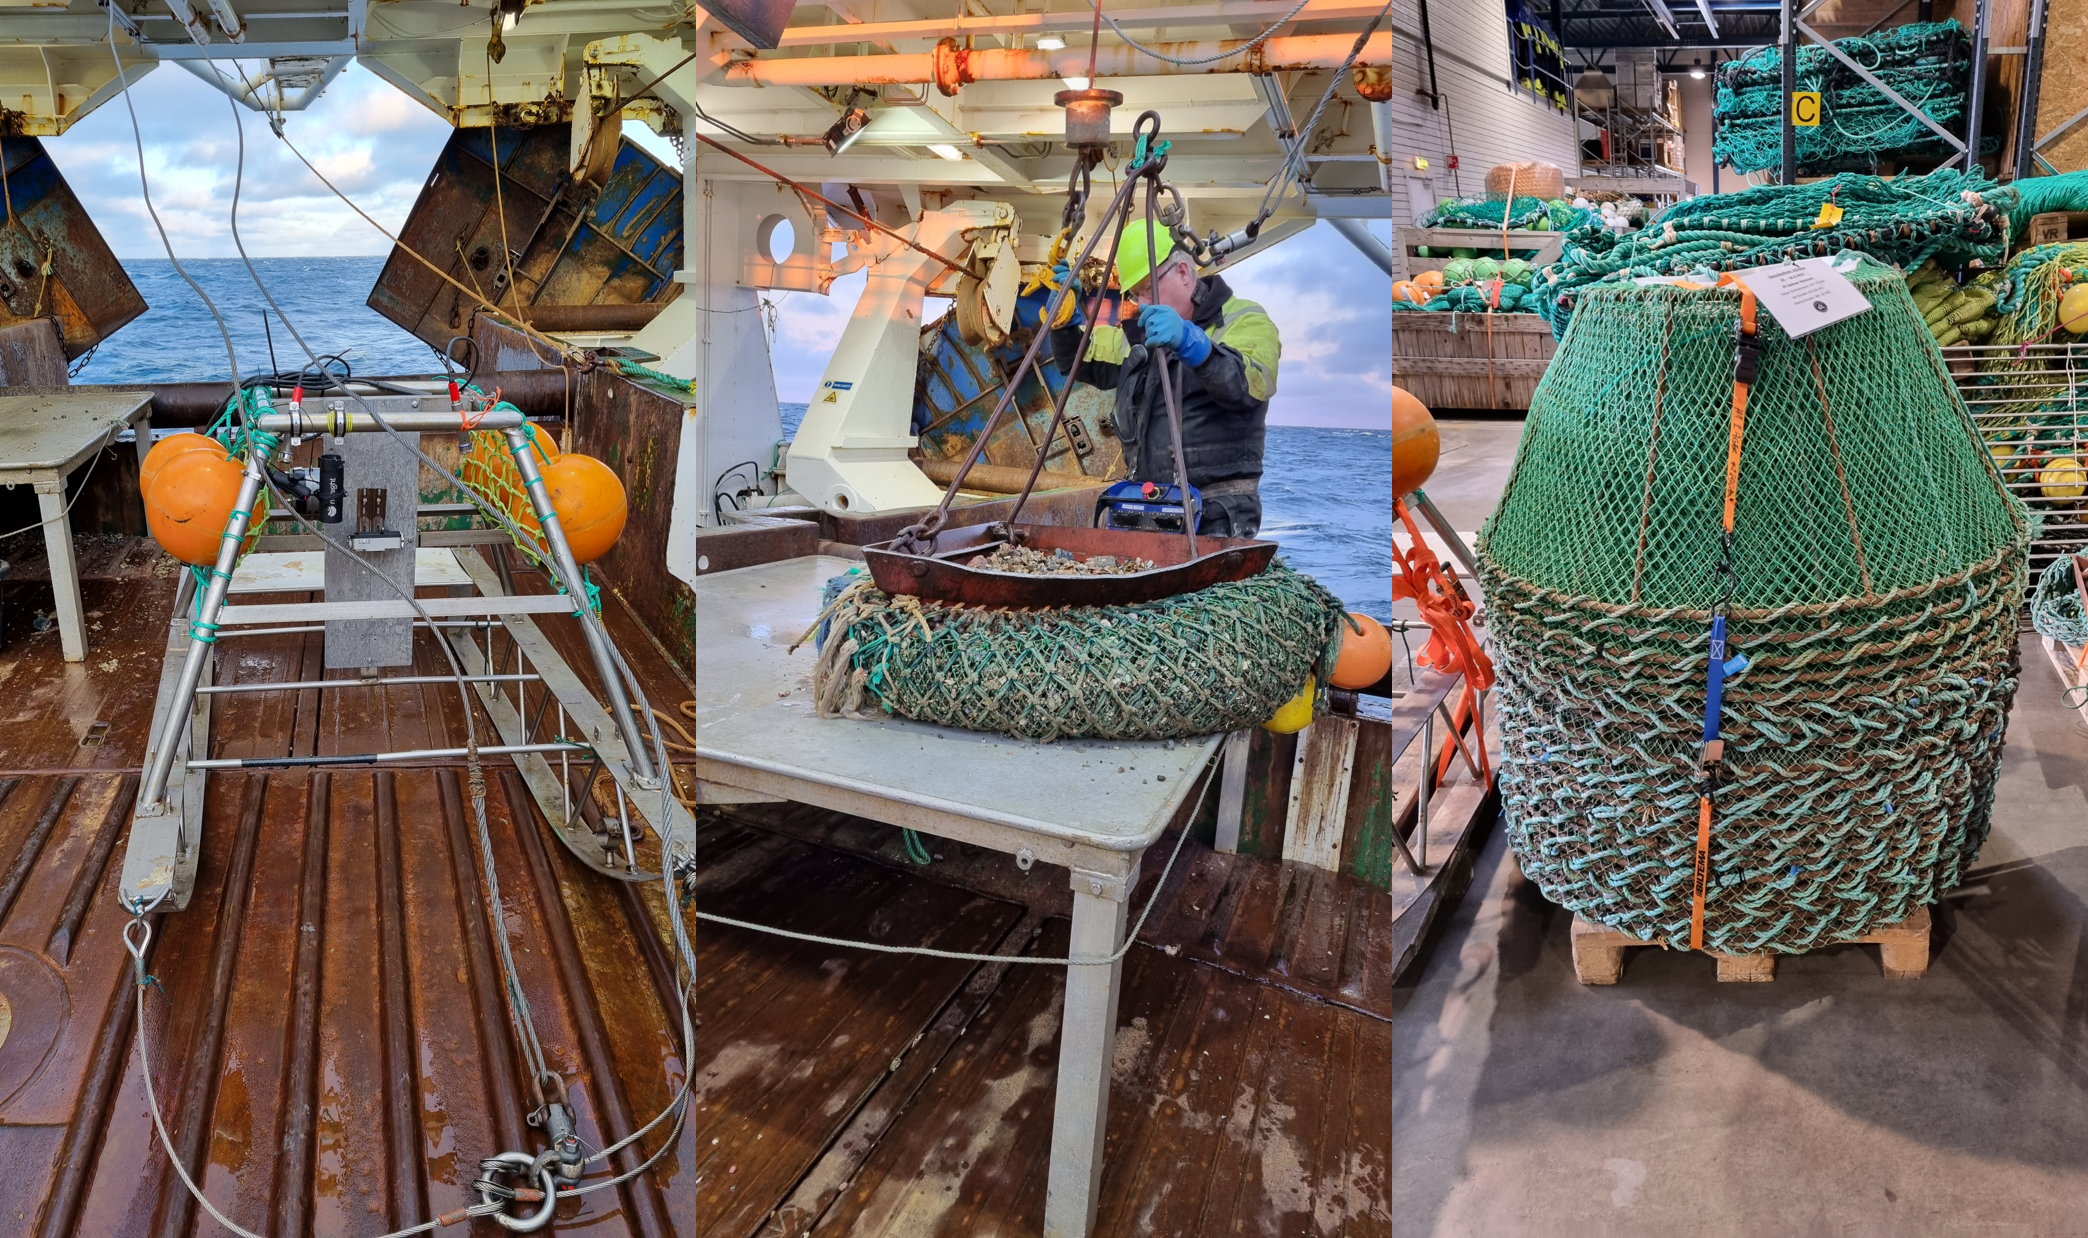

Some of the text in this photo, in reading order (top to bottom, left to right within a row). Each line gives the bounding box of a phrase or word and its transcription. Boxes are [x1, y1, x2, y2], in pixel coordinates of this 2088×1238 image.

[1796, 95, 1816, 123] C
[2042, 227, 2059, 240] VR
[1695, 850, 1706, 894] BILTEMA
